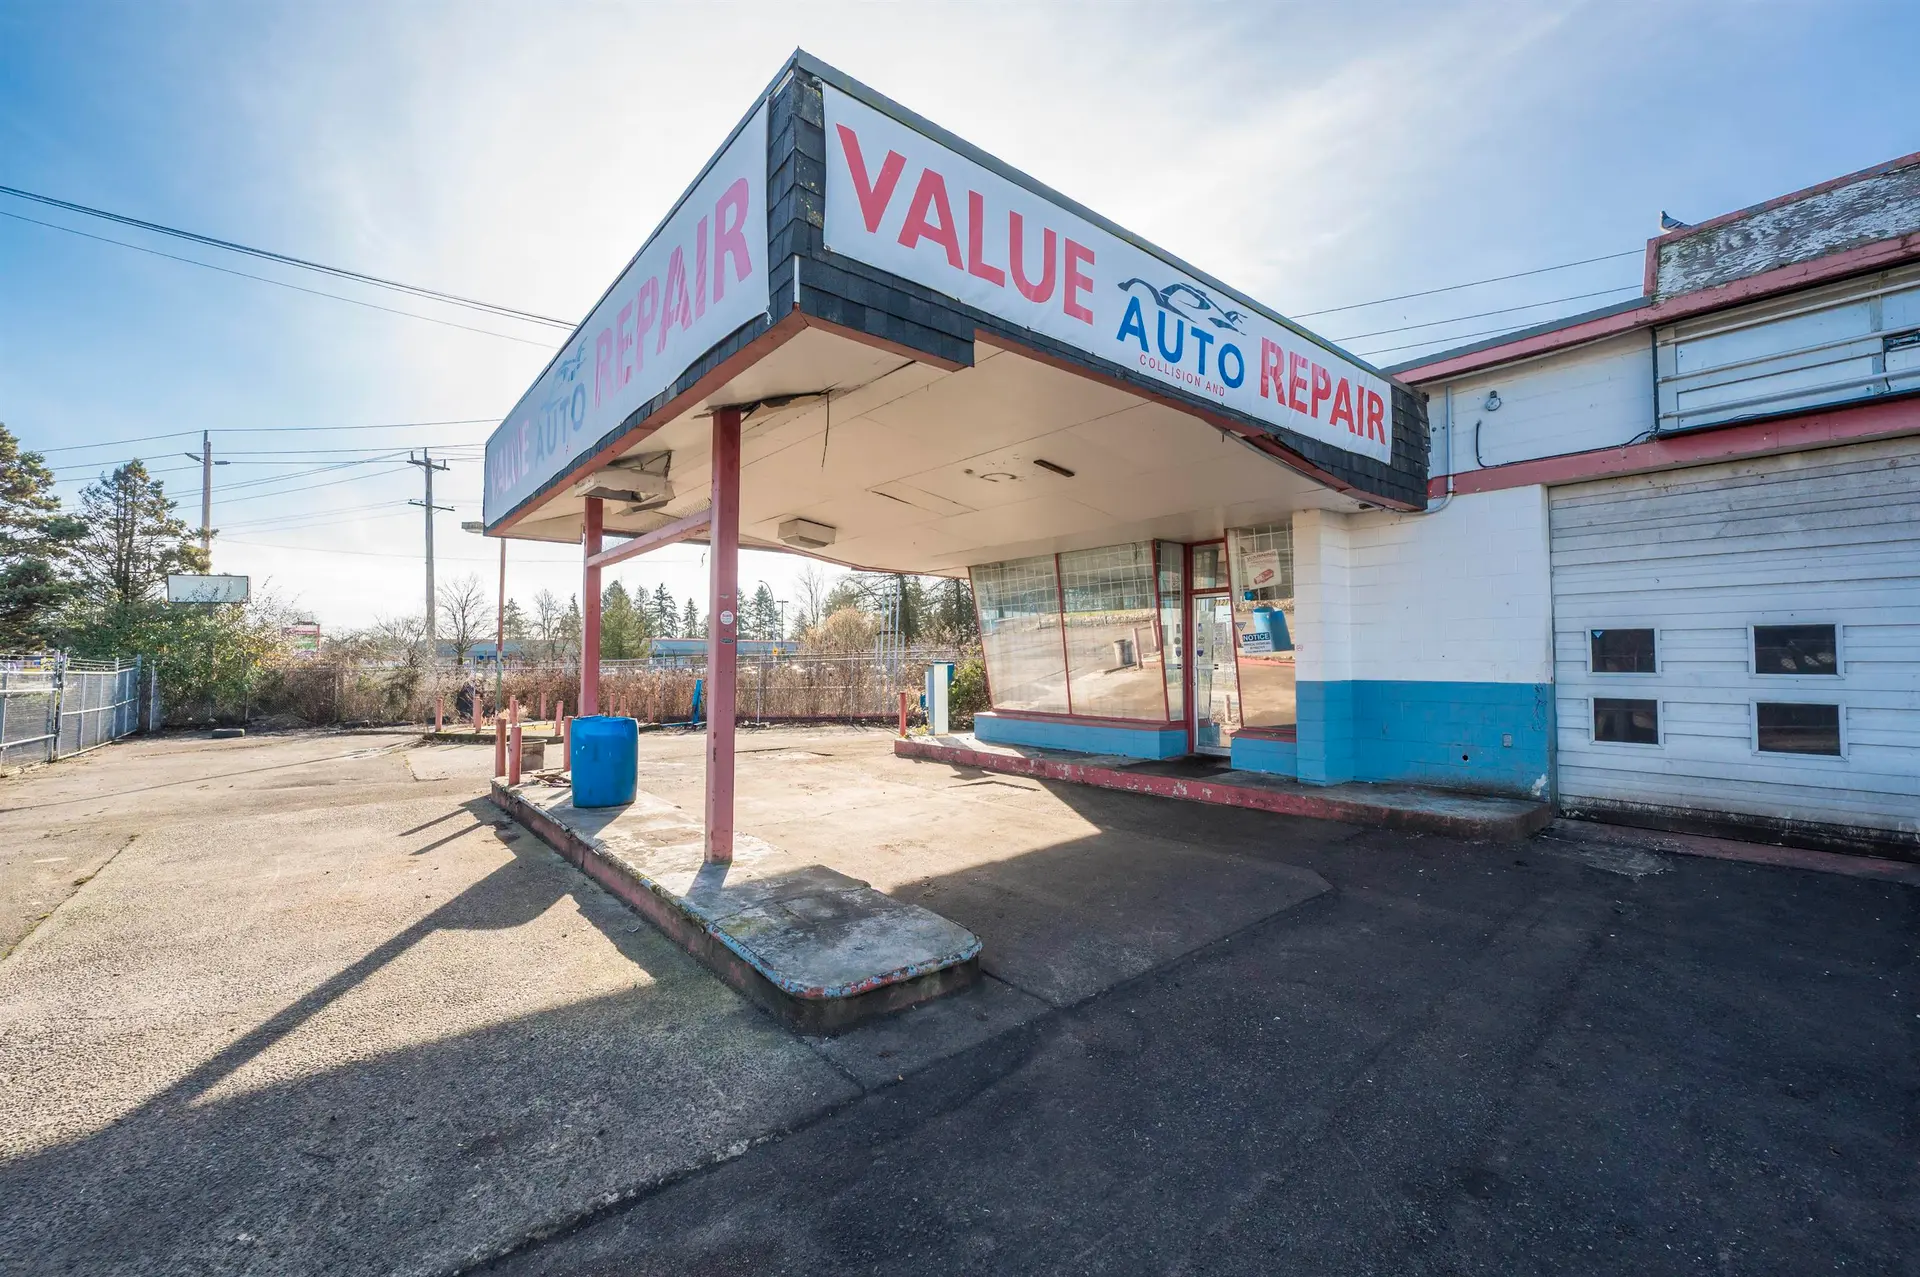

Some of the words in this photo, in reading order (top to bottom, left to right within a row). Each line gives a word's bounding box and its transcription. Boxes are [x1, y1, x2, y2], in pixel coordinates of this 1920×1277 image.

[490, 419, 530, 504] VALUE
[535, 383, 586, 470] AUTO
[594, 177, 753, 410] REPAIR
[836, 123, 1095, 326] VALUE
[1116, 296, 1245, 389] AUTO
[1259, 337, 1386, 446] REPAIR
[1139, 354, 1201, 387] COLLISION
[1205, 381, 1225, 397] AND
[1243, 632, 1270, 641] NOTICE
